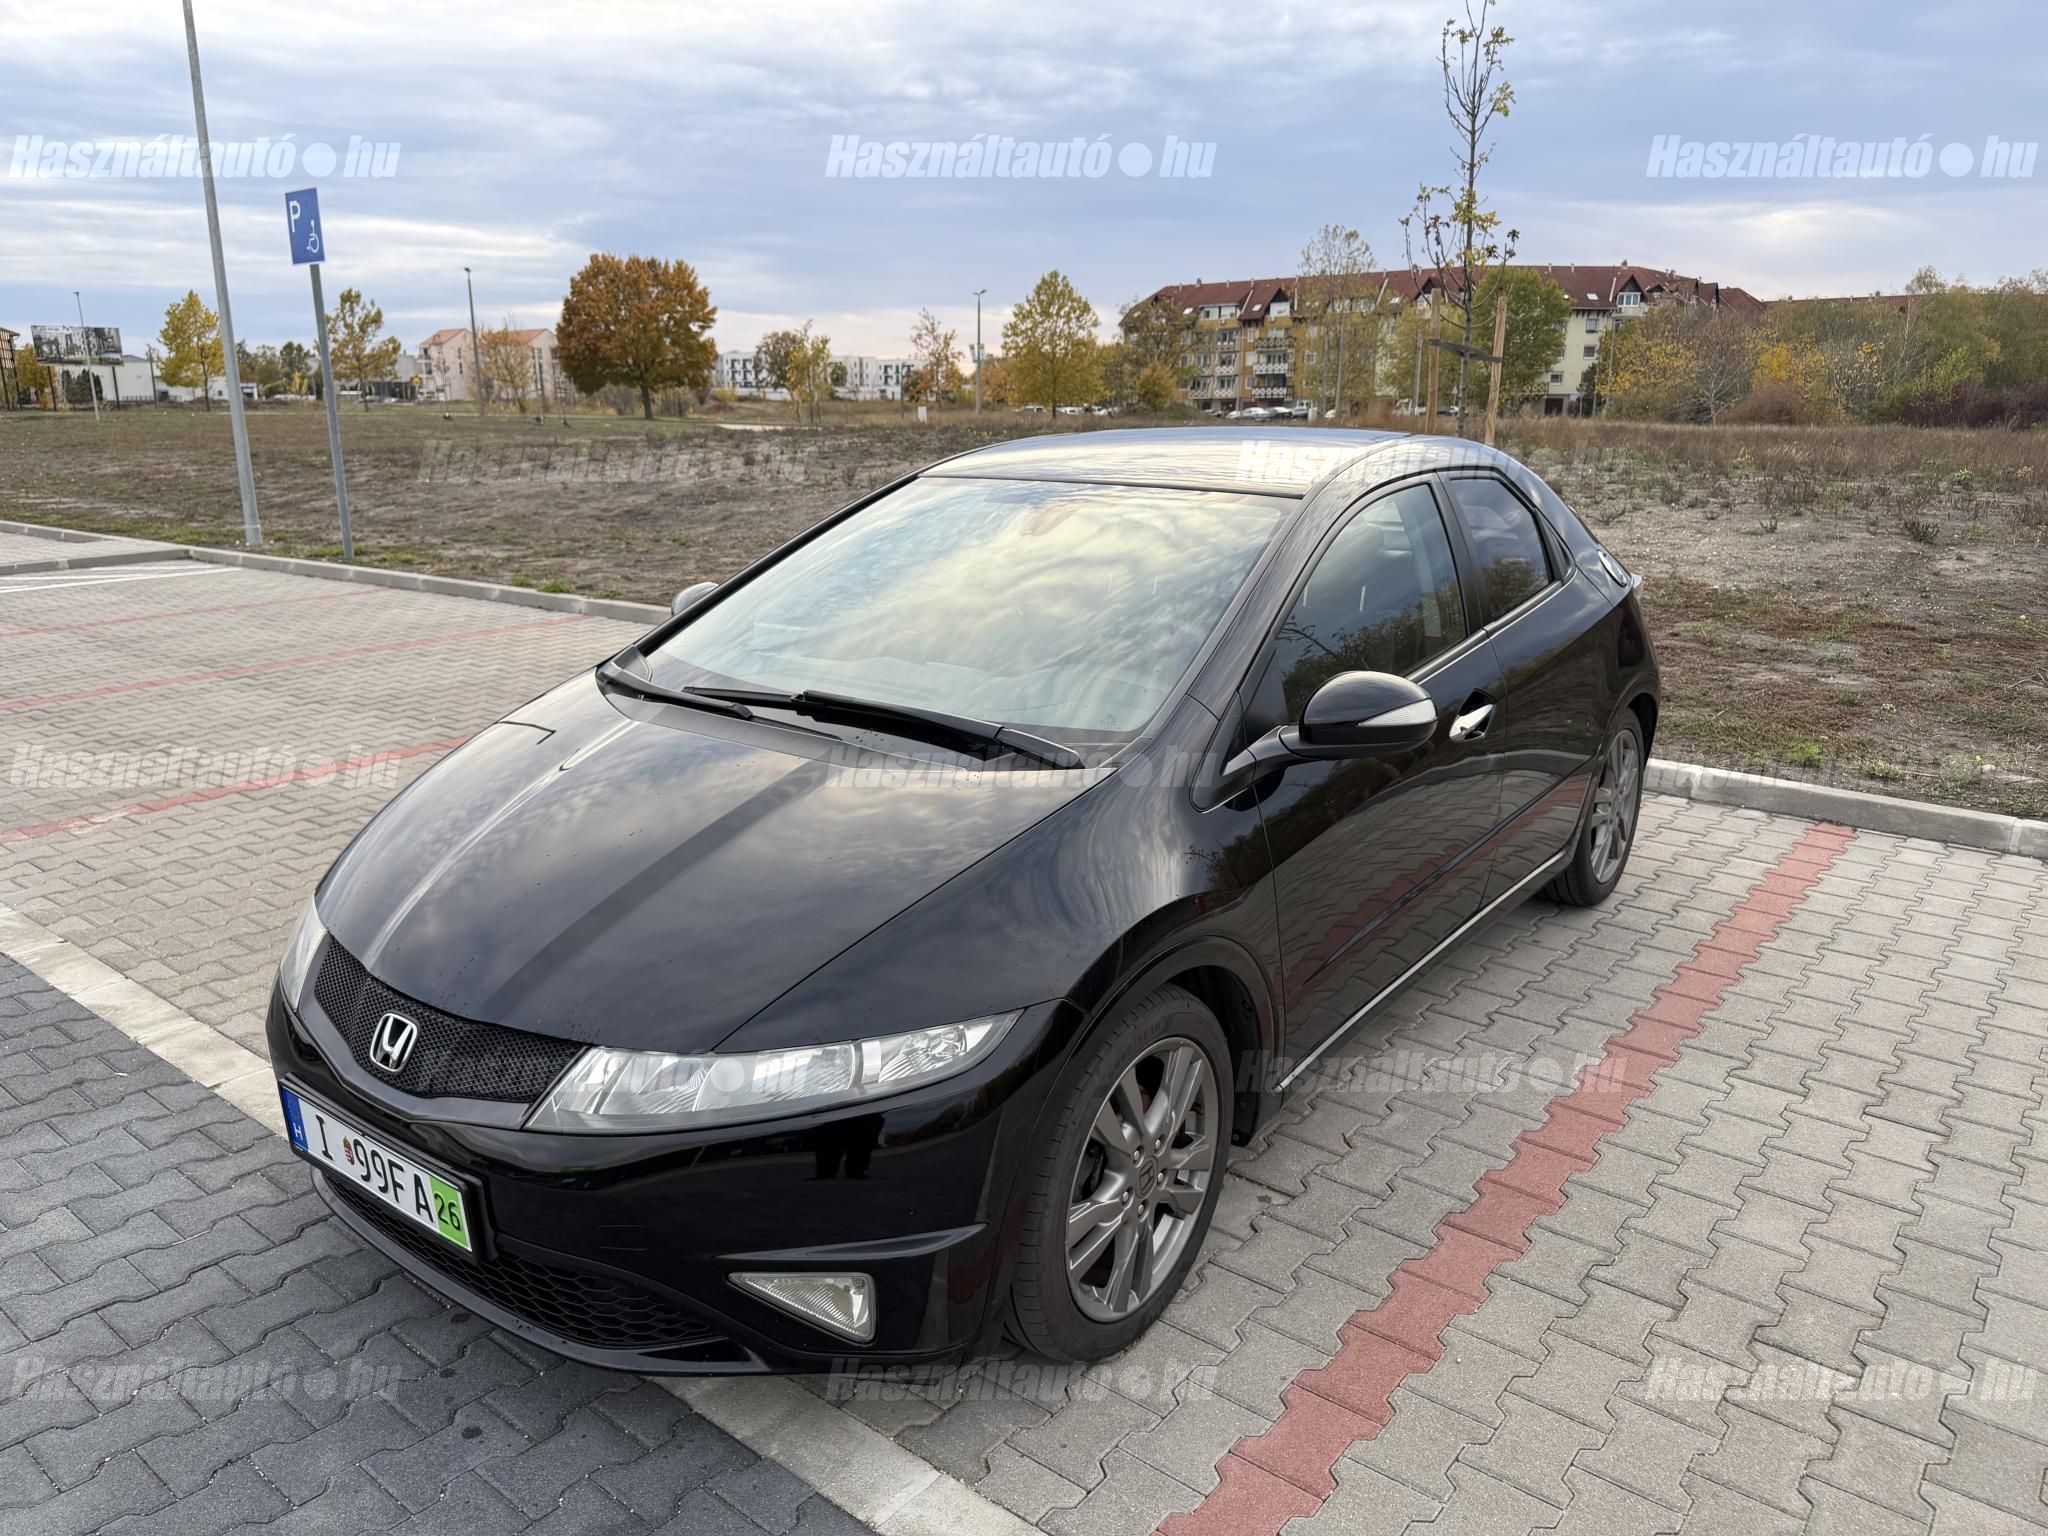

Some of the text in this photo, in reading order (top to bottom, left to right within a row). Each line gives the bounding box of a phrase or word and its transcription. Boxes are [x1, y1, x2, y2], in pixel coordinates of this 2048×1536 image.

[289, 200, 300, 233] P
[293, 1124, 303, 1139] H
[433, 1192, 461, 1231] 26
